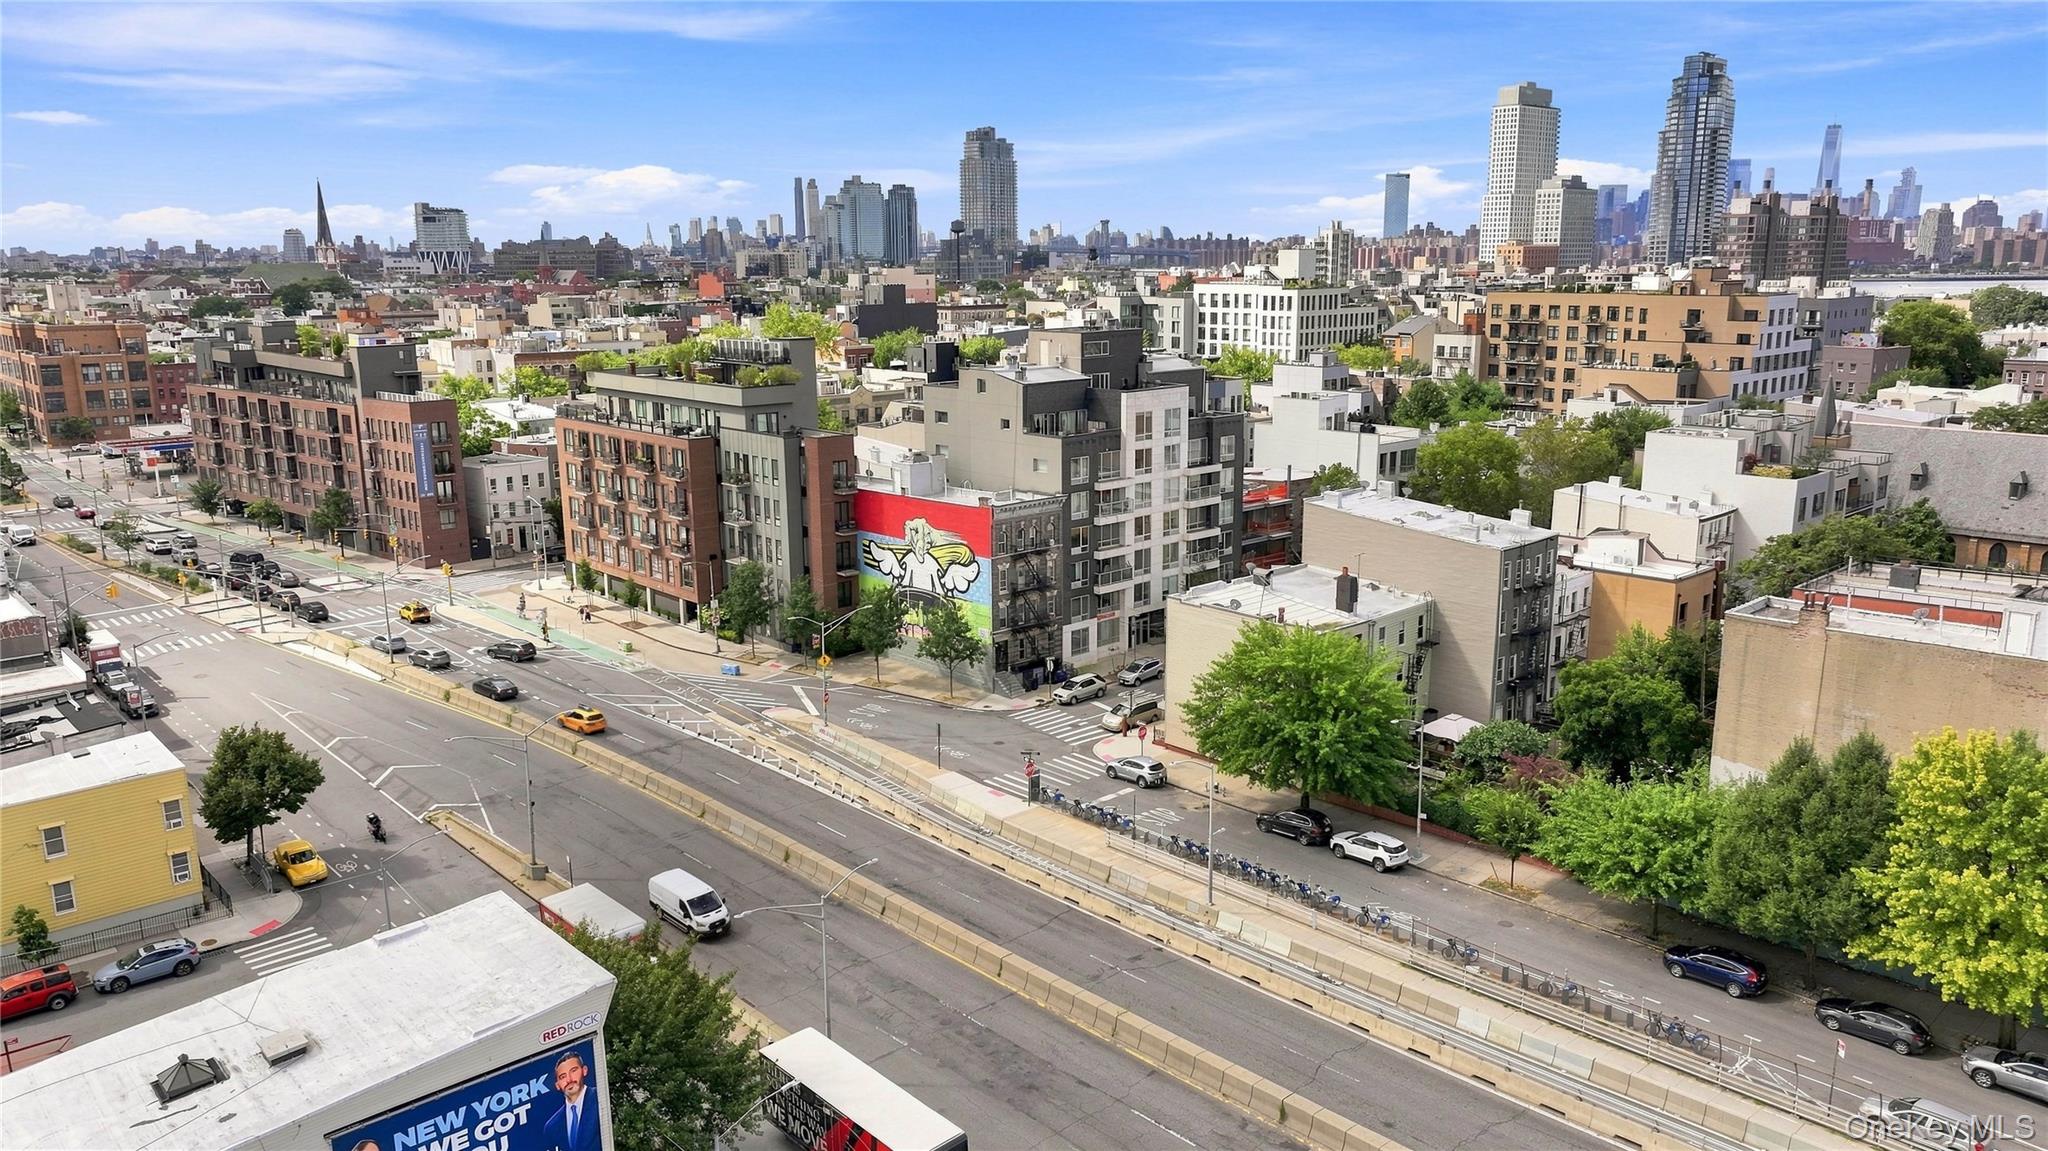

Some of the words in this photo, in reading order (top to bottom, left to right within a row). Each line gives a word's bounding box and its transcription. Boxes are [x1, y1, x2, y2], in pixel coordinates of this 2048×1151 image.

[543, 1013, 599, 1042] REDROCK
[393, 1106, 467, 1151] NEW
[471, 1073, 550, 1120] YORK
[418, 1128, 470, 1151] WE
[474, 1103, 531, 1141] GOT
[765, 1099, 786, 1126] WE
[788, 1113, 828, 1151] MOVE
[787, 1100, 805, 1123] THE
